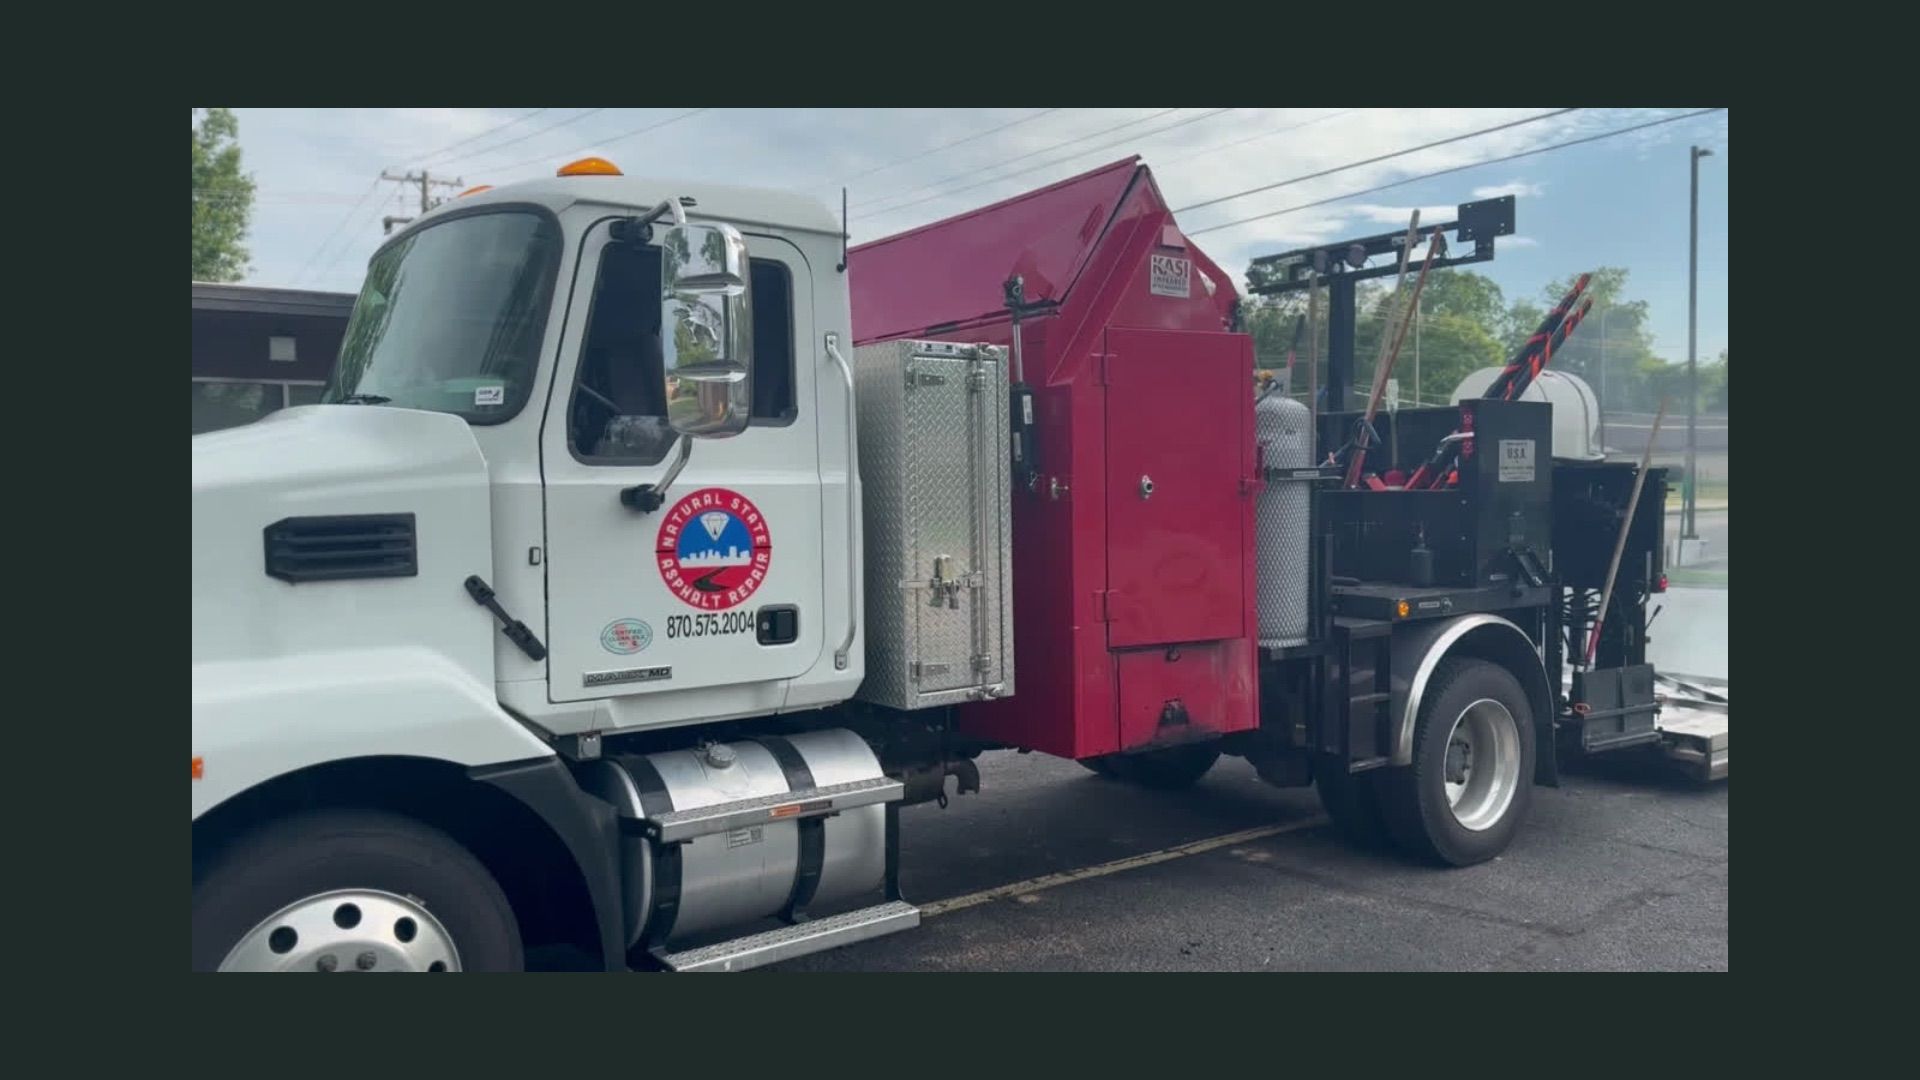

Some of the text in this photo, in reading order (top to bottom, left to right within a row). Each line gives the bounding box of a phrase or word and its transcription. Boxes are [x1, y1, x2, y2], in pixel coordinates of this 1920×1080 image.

[1152, 256, 1188, 278] KASI
[662, 493, 767, 548] NATURAL STATE
[662, 553, 769, 608] ASPHALT REPAIR
[667, 611, 755, 638] 870.575.2004
[648, 668, 670, 678] MD
